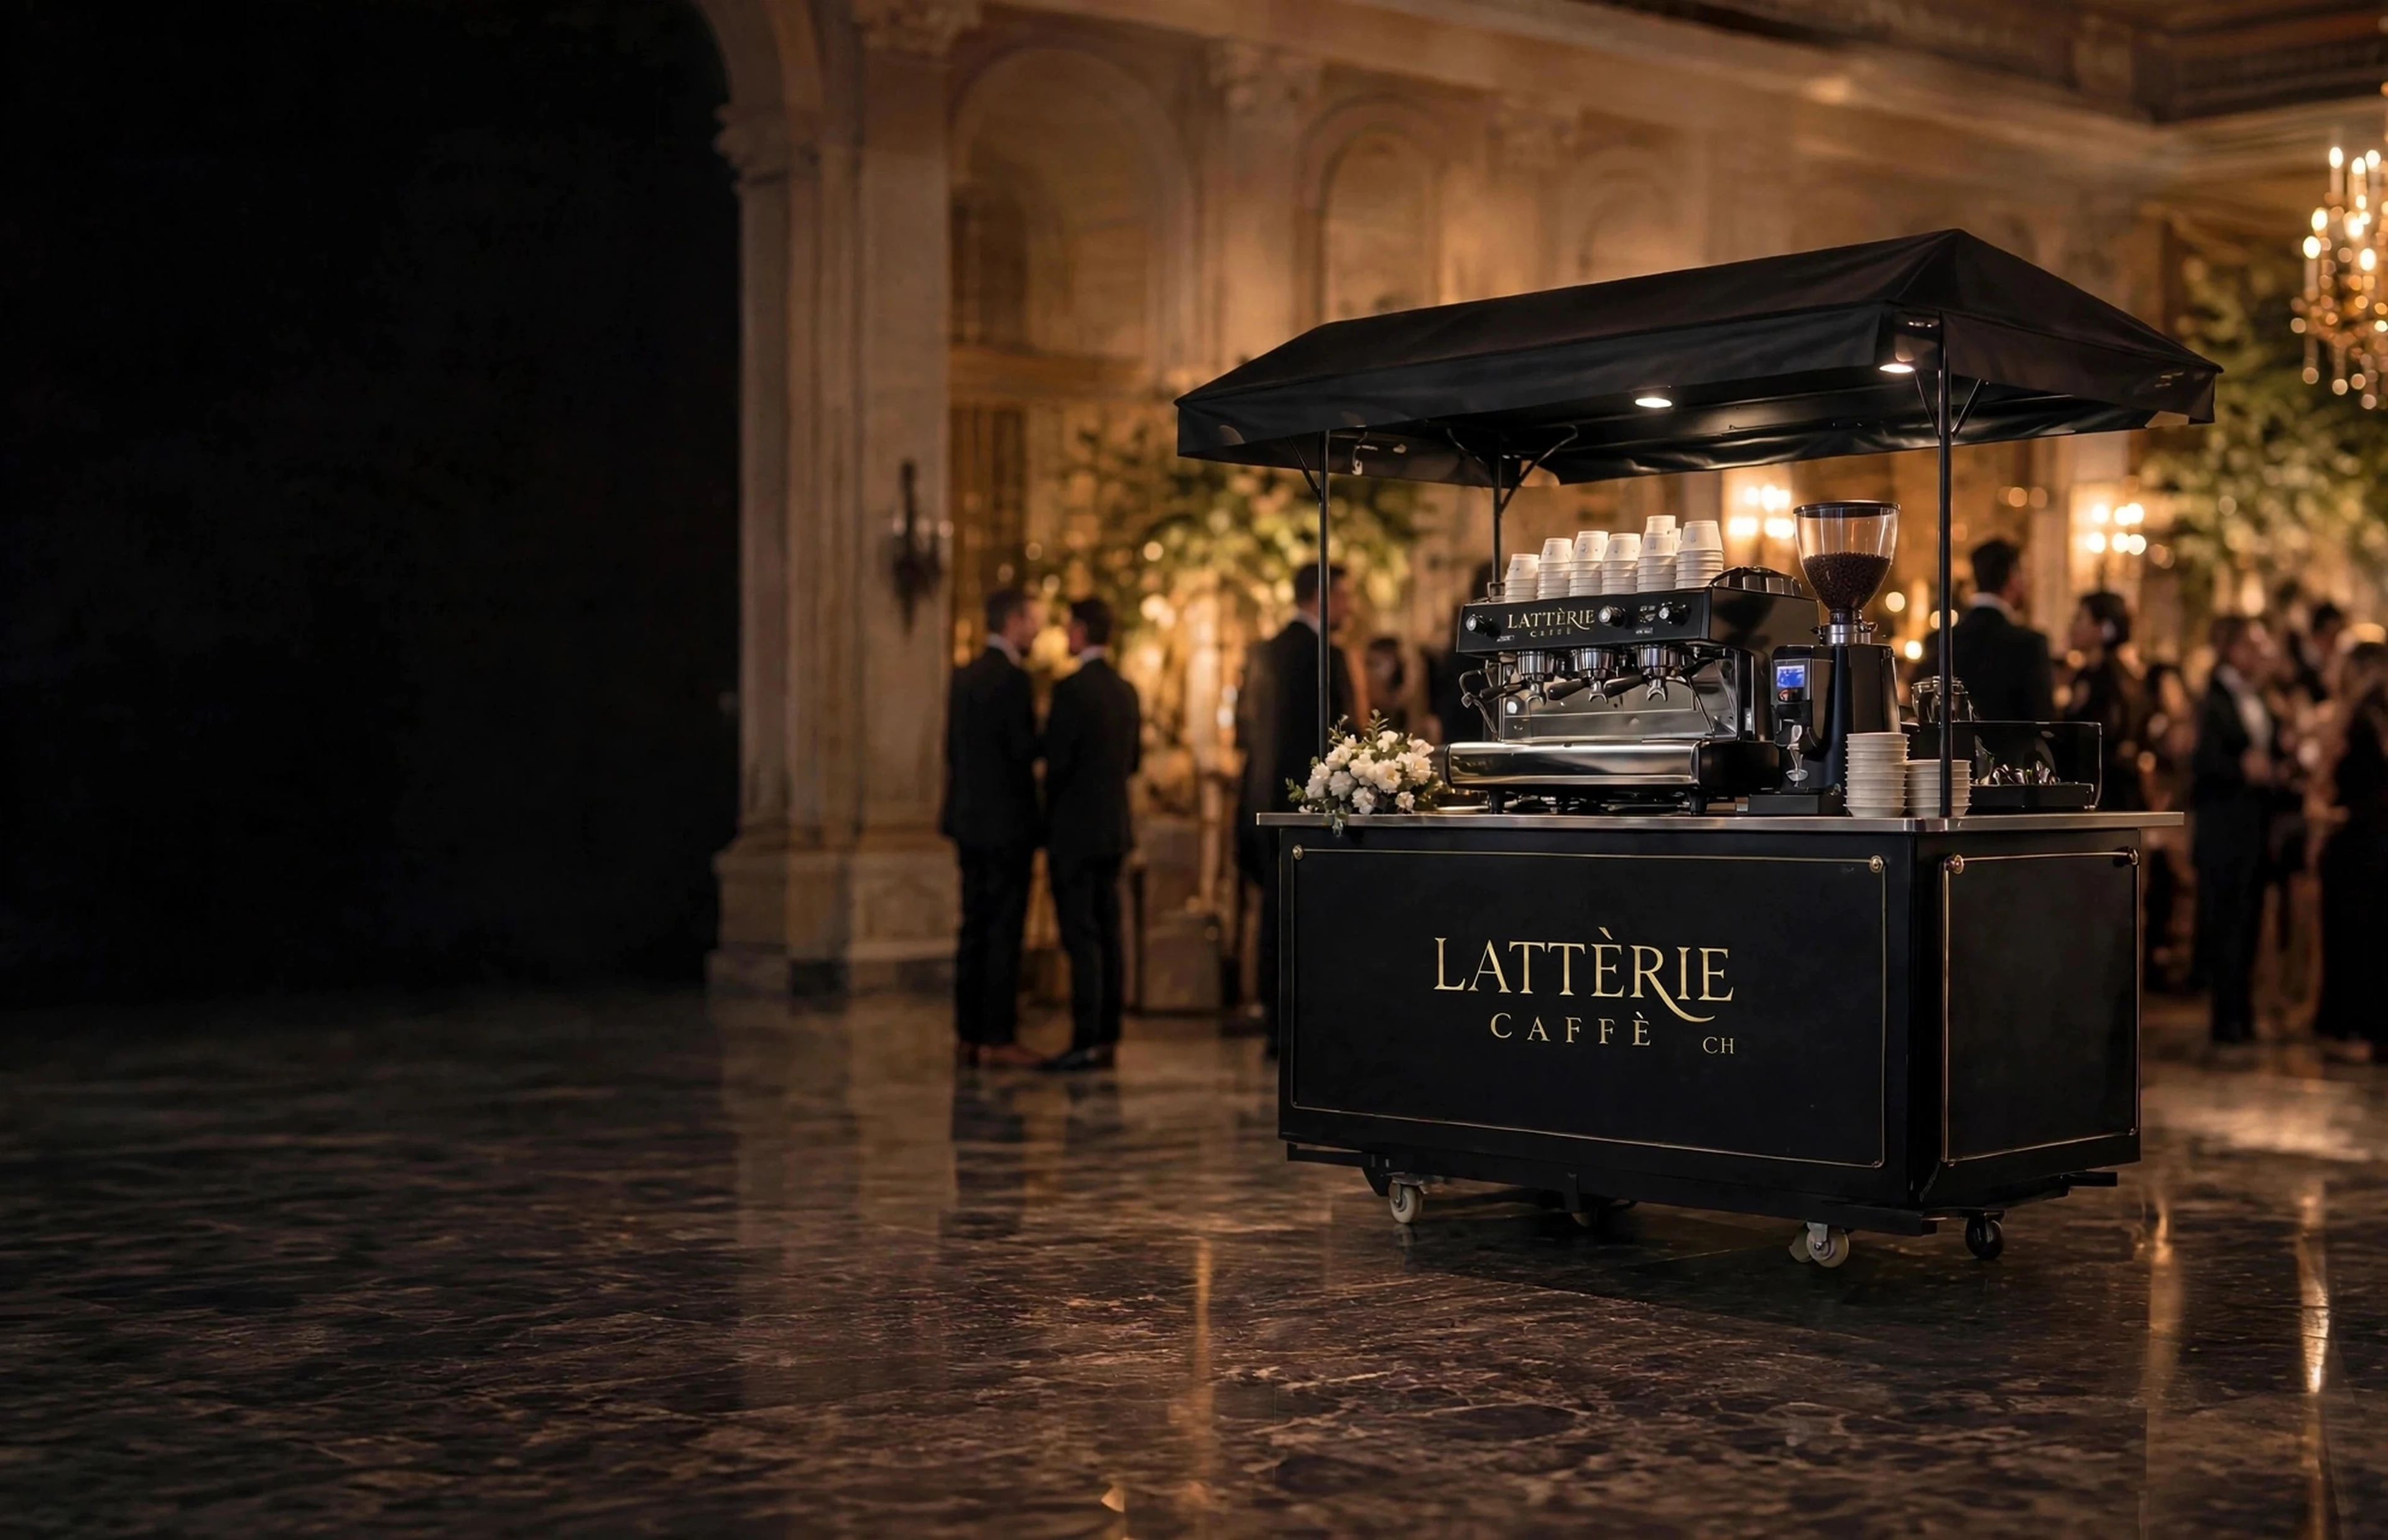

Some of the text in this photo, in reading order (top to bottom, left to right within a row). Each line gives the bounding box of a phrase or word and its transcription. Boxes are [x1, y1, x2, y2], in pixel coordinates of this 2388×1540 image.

[1507, 607, 1595, 630] LATTÈRIE
[1434, 926, 1734, 1023] LATTÈRIE
[1491, 1012, 1650, 1046] CAFFÈ
[1703, 1036, 1734, 1054] CH
